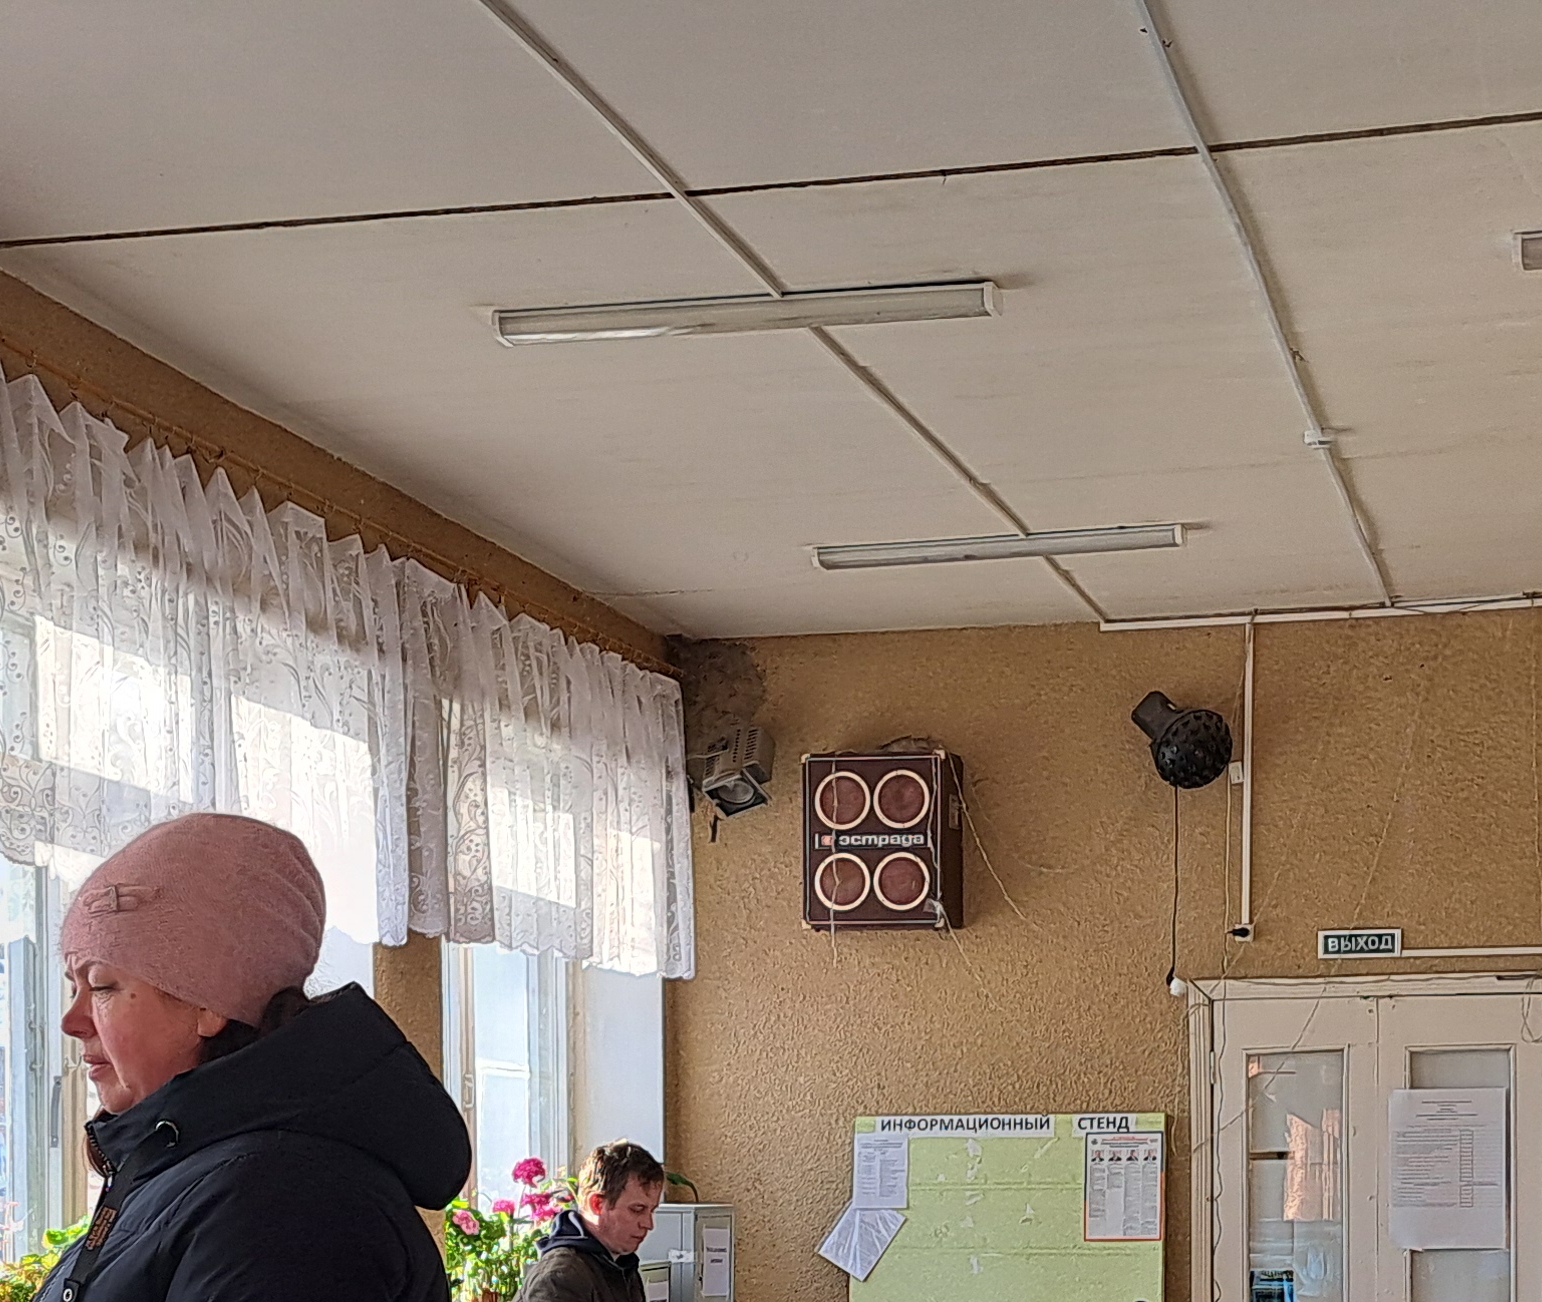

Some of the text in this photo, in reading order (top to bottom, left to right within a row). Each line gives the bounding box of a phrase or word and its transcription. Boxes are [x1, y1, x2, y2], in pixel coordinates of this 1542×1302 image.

[1328, 936, 1393, 952] ВЫХОД
[880, 1113, 1130, 1133] ИНФОРМАЦИОННЫЙ СТЕНД
